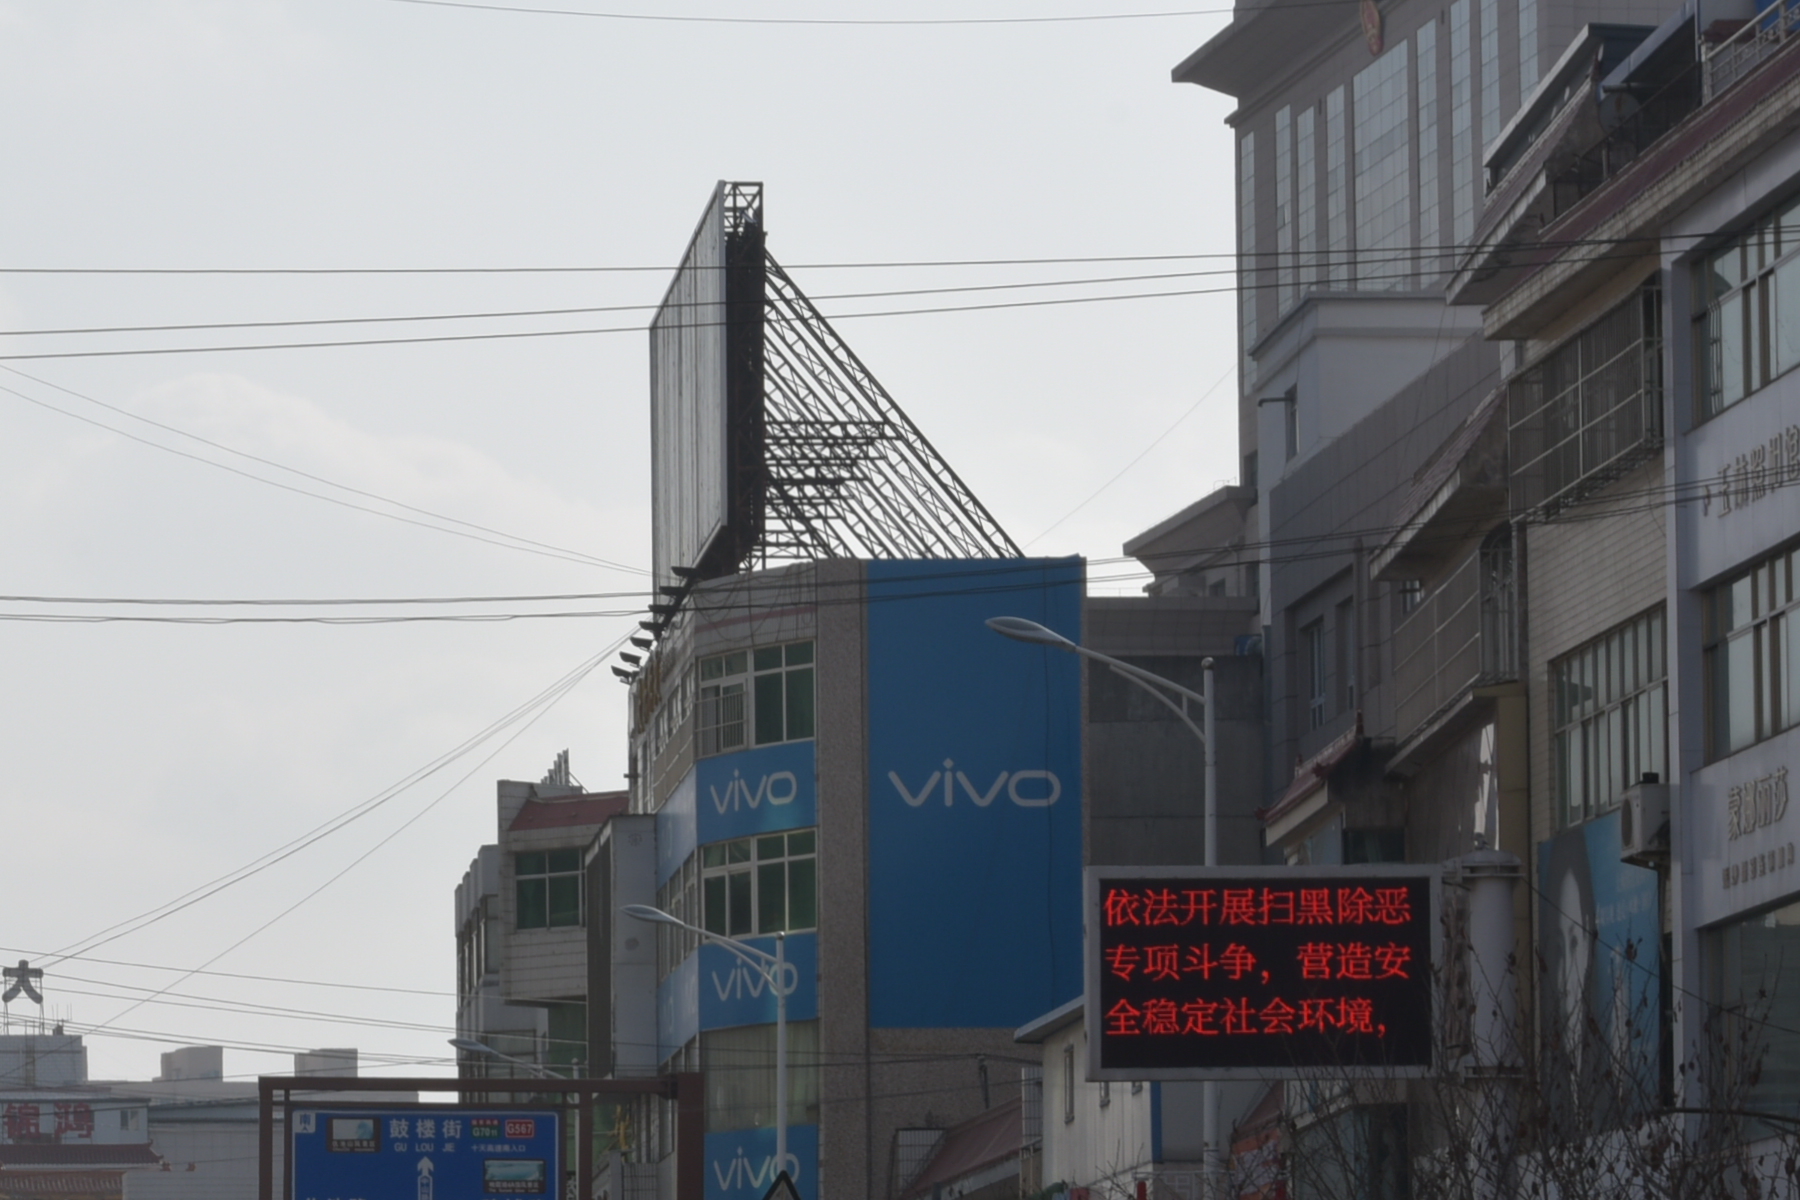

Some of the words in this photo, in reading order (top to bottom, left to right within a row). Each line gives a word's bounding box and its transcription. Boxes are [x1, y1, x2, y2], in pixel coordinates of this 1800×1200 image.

[710, 769, 797, 814] vivo
[888, 758, 1061, 808] vivo
[1104, 886, 1412, 928] 依法开展扫黑除恶
[712, 958, 799, 1002] vivo
[1104, 942, 1412, 982] 专项斗争，营造安
[1104, 996, 1390, 1038] 全稳定社会环境，
[388, 1118, 464, 1140] 鼓楼街
[393, 1143, 408, 1153] GU
[415, 1143, 434, 1153] LOU
[507, 1123, 533, 1135] G567
